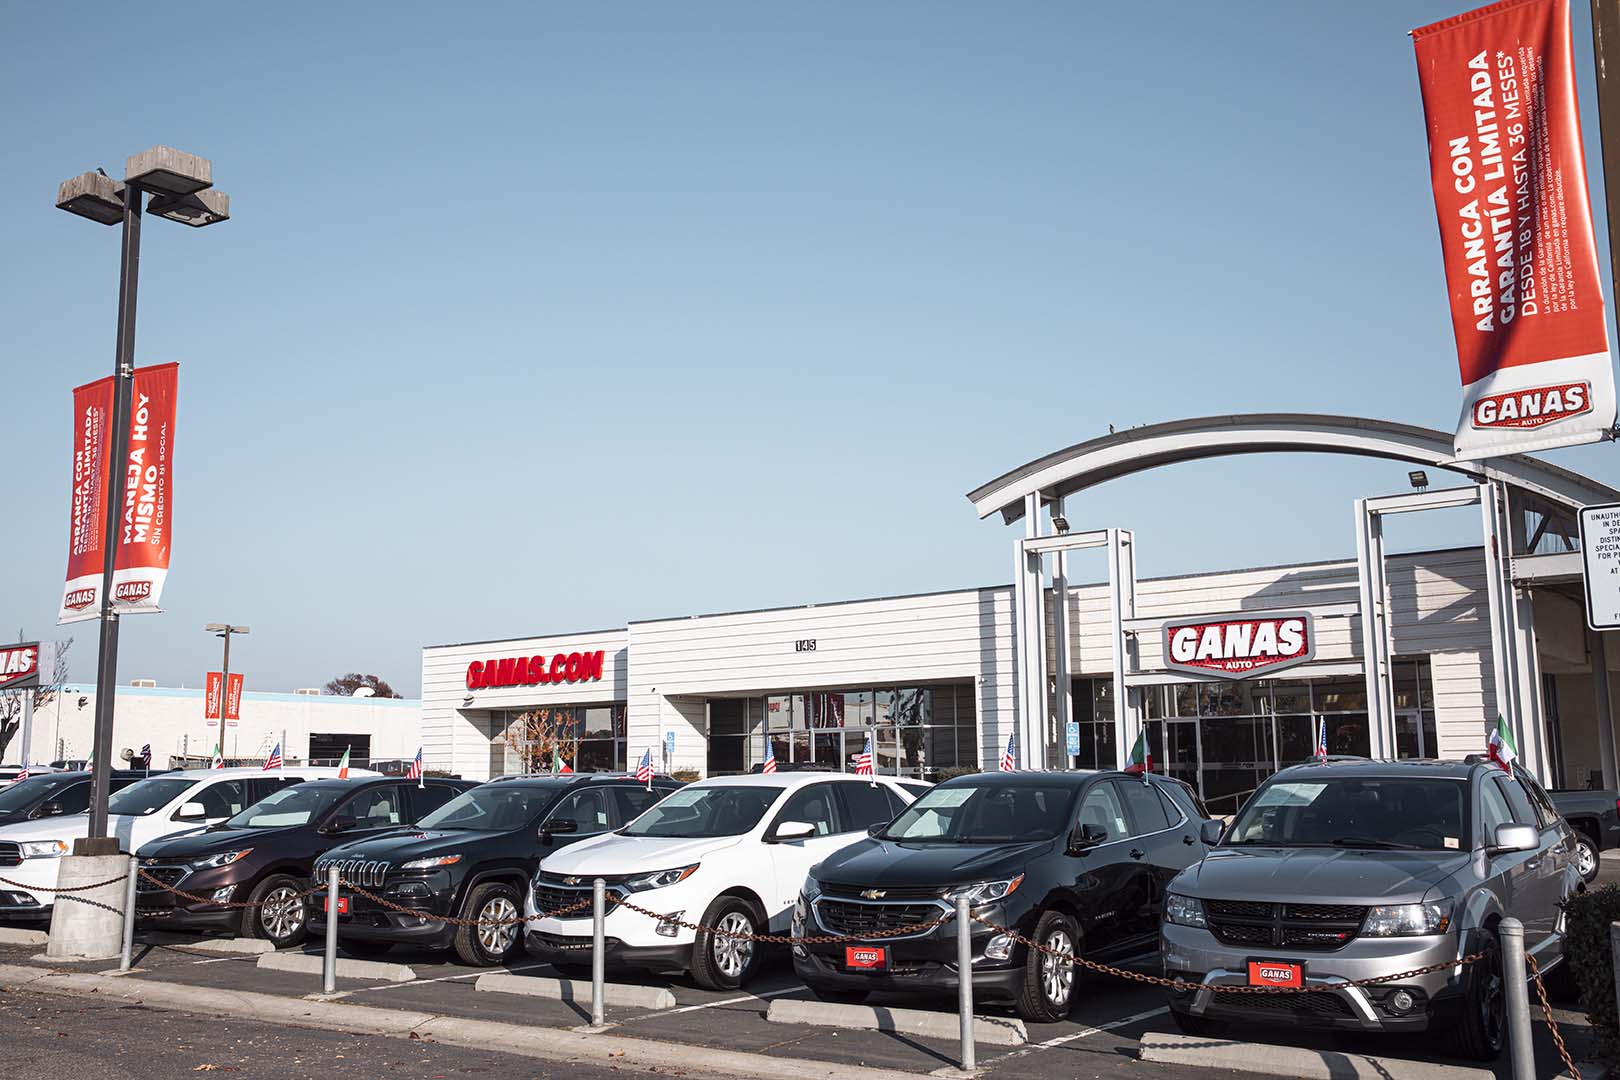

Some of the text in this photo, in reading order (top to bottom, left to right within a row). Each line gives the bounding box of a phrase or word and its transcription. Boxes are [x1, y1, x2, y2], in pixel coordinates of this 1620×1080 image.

[1518, 47, 1528, 77] requerida
[1527, 46, 1535, 71] detalles
[1523, 78, 1532, 104] Limitada
[1507, 123, 1525, 147] 36
[1468, 49, 1516, 324] GARANTÍA LIMITADA
[1512, 148, 1530, 211] HASTA
[1548, 183, 1554, 191] La
[1518, 216, 1530, 227] Y
[1544, 220, 1550, 229] un
[1559, 201, 1567, 228] requiere
[1449, 135, 1494, 332] ARRANCA CON
[1520, 230, 1532, 250] 18
[1545, 231, 1551, 239] de
[1554, 228, 1559, 237] en
[1562, 229, 1567, 237] no
[1546, 242, 1554, 272] California
[1554, 238, 1563, 265] Limitada
[1563, 239, 1571, 269] California
[1540, 267, 1546, 275] de
[1550, 273, 1556, 281] de
[1566, 270, 1573, 278] de
[1520, 251, 1538, 317] DESDE
[1540, 276, 1550, 304] duración
[1561, 303, 1568, 311] de
[1570, 298, 1578, 309] por
[1477, 386, 1584, 424] GANAS
[1520, 417, 1544, 426] AUTO
[124, 393, 149, 545] MANEJA HOY
[160, 464, 166, 475] NI
[79, 406, 92, 554] GARANTÍA LIMITADA
[134, 465, 158, 543] MISMO
[155, 478, 165, 525] CRÉDITO
[74, 485, 82, 556] ARRANCA
[1591, 512, 1620, 521] UNAUTH
[151, 528, 163, 545] SIN
[65, 589, 95, 605] GANAS
[117, 583, 149, 597] GANAS
[796, 639, 816, 651] 145
[1171, 619, 1304, 662] GANAS
[466, 650, 605, 689] GANAS.COM
[1226, 661, 1253, 669] AUTO
[854, 952, 877, 961] GANAS
[1262, 969, 1291, 979] GANAS
